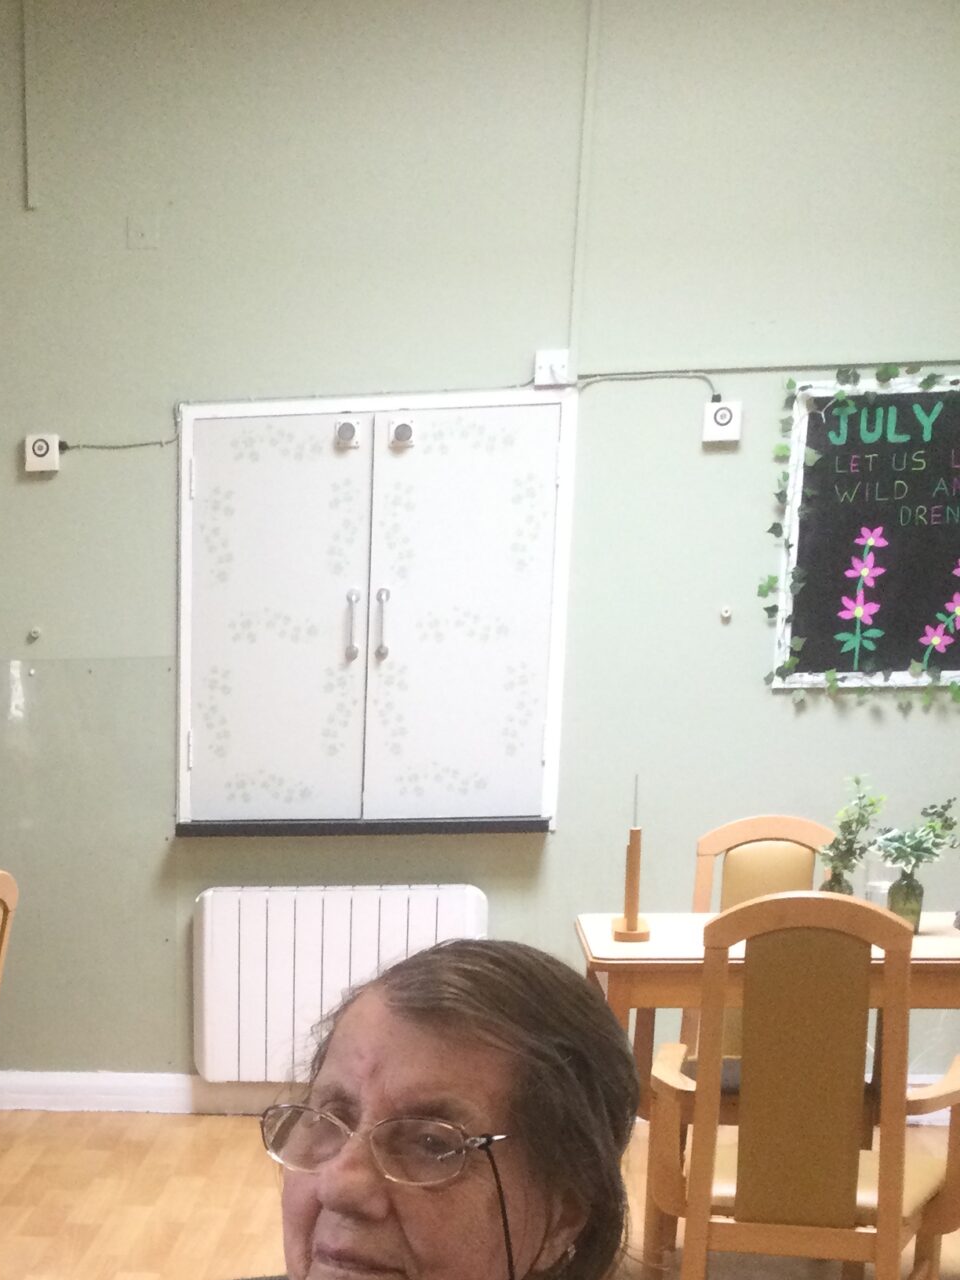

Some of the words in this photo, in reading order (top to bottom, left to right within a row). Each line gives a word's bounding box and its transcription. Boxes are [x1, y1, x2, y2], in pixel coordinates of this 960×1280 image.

[828, 401, 944, 445] JULY
[835, 453, 878, 473] LET
[892, 450, 927, 471] US
[835, 480, 909, 503] WILD
